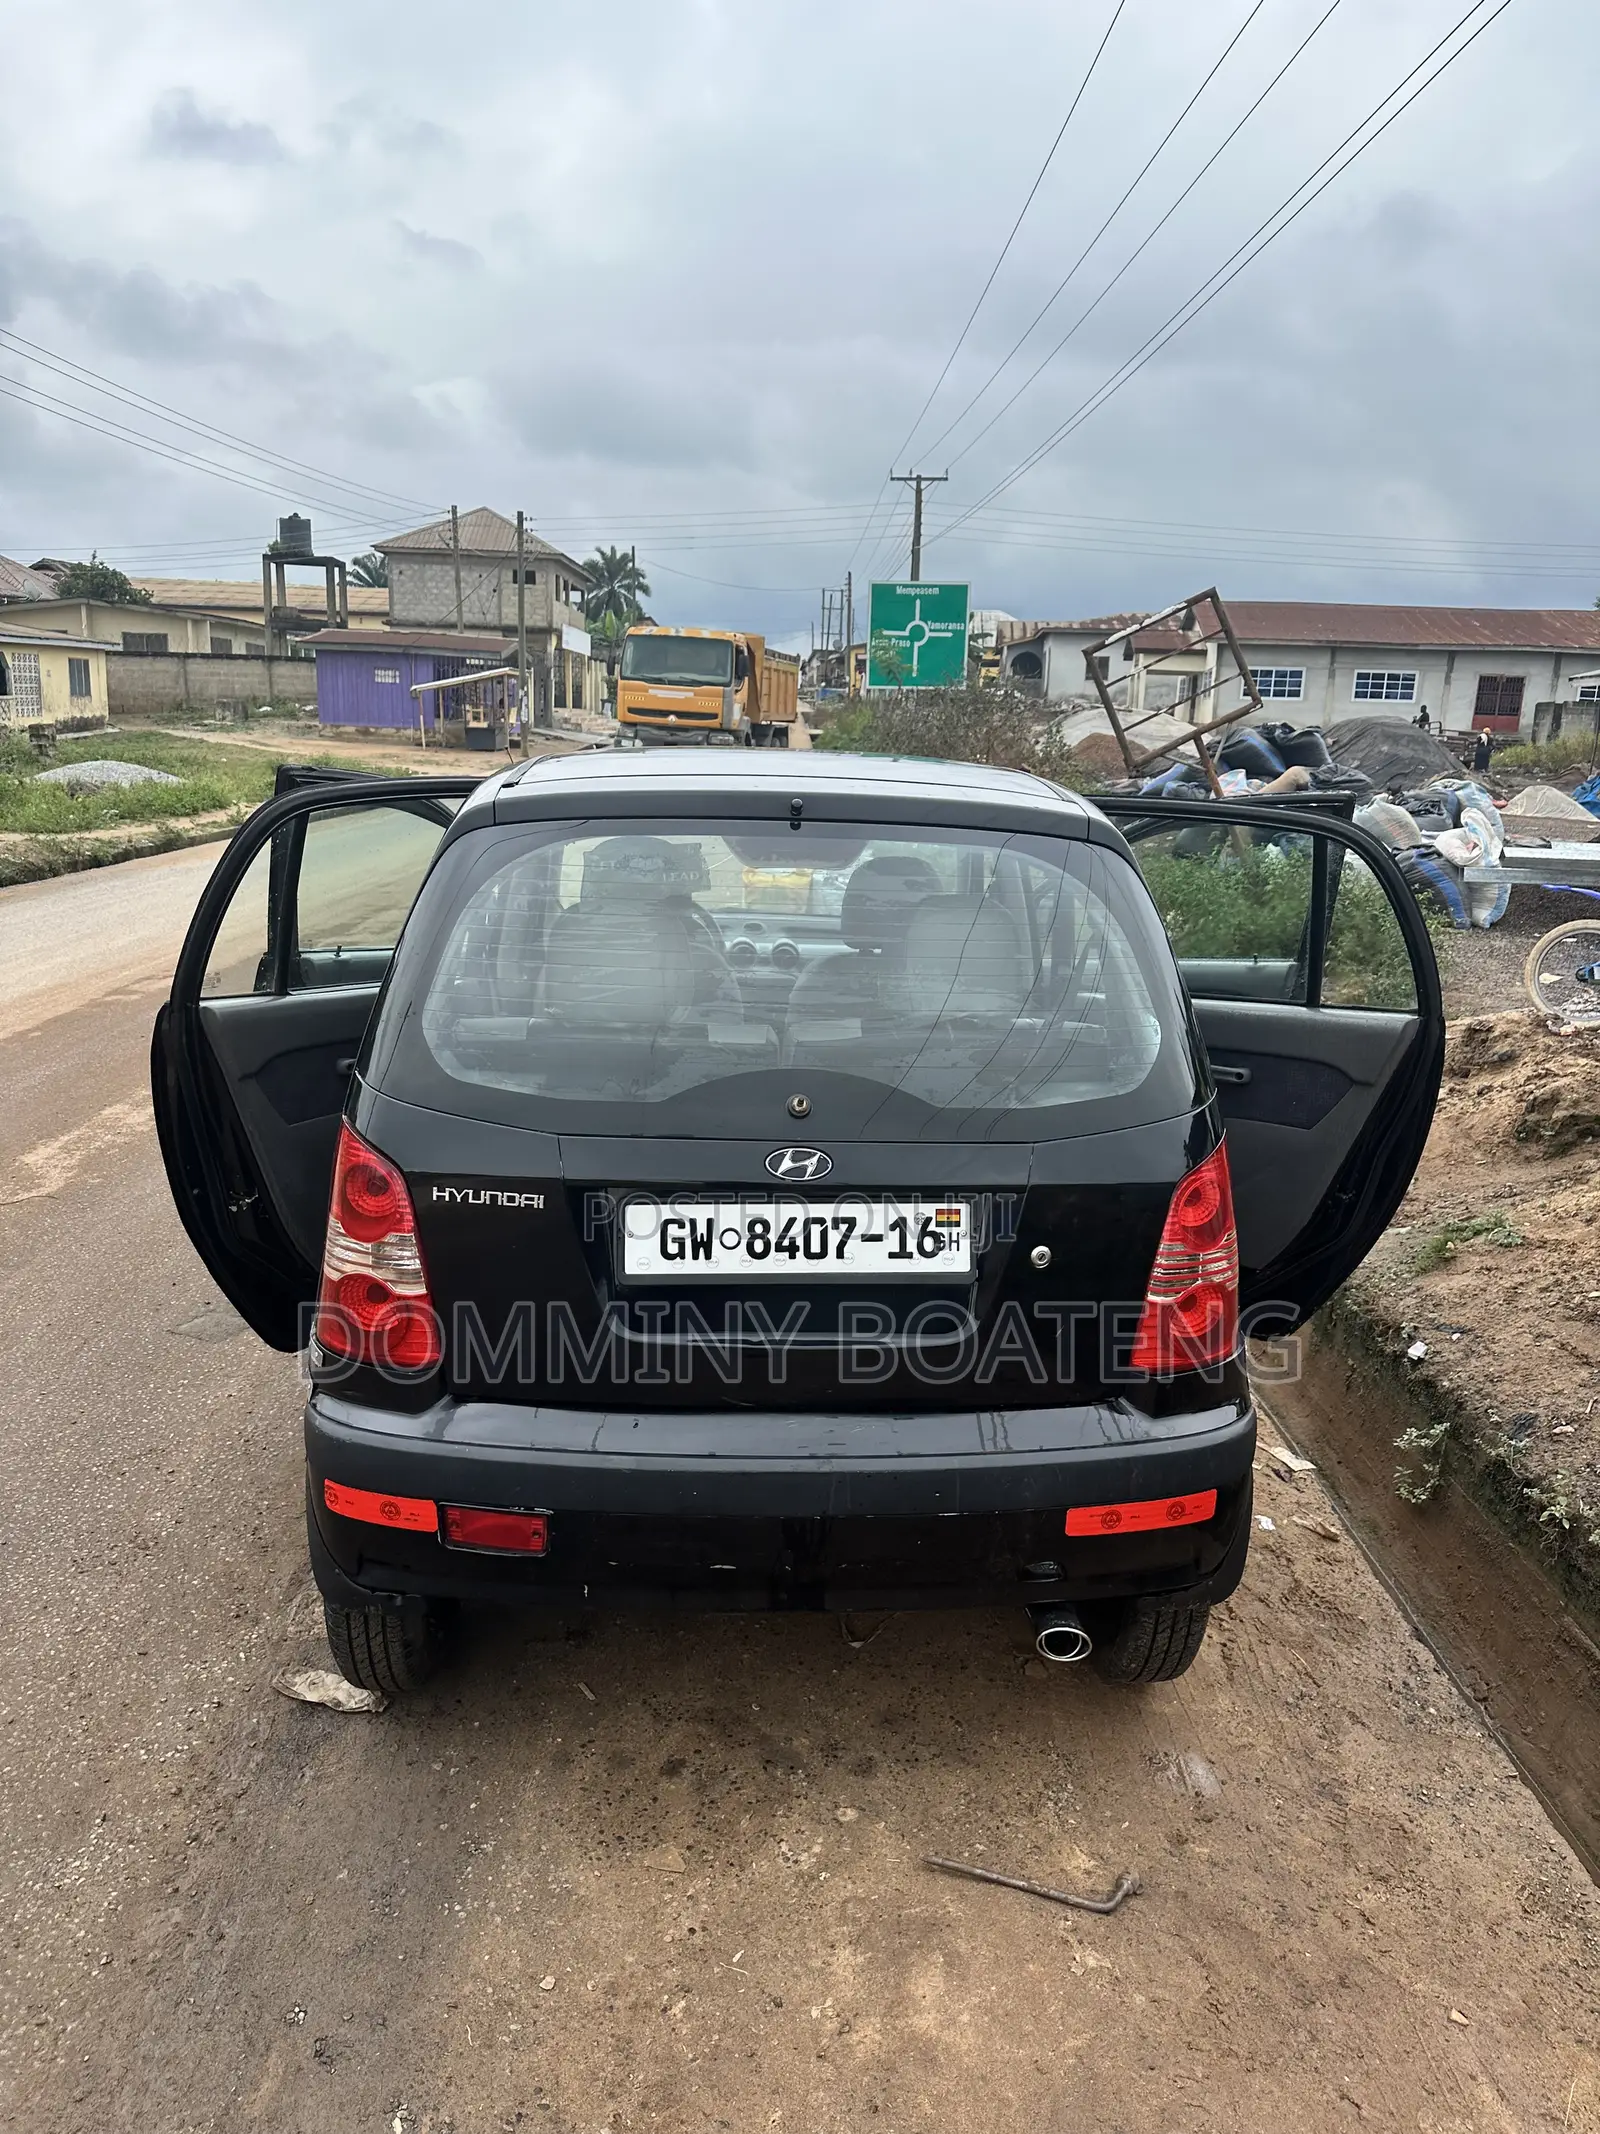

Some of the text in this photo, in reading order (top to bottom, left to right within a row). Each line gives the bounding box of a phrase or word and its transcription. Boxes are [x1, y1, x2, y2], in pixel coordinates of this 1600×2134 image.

[896, 586, 939, 596] Mempeasem
[927, 621, 965, 630] Yamoransa
[891, 638, 911, 647] Praso
[432, 1186, 545, 1209] HYUNDAI
[659, 1215, 941, 1261] GW 8407-16
